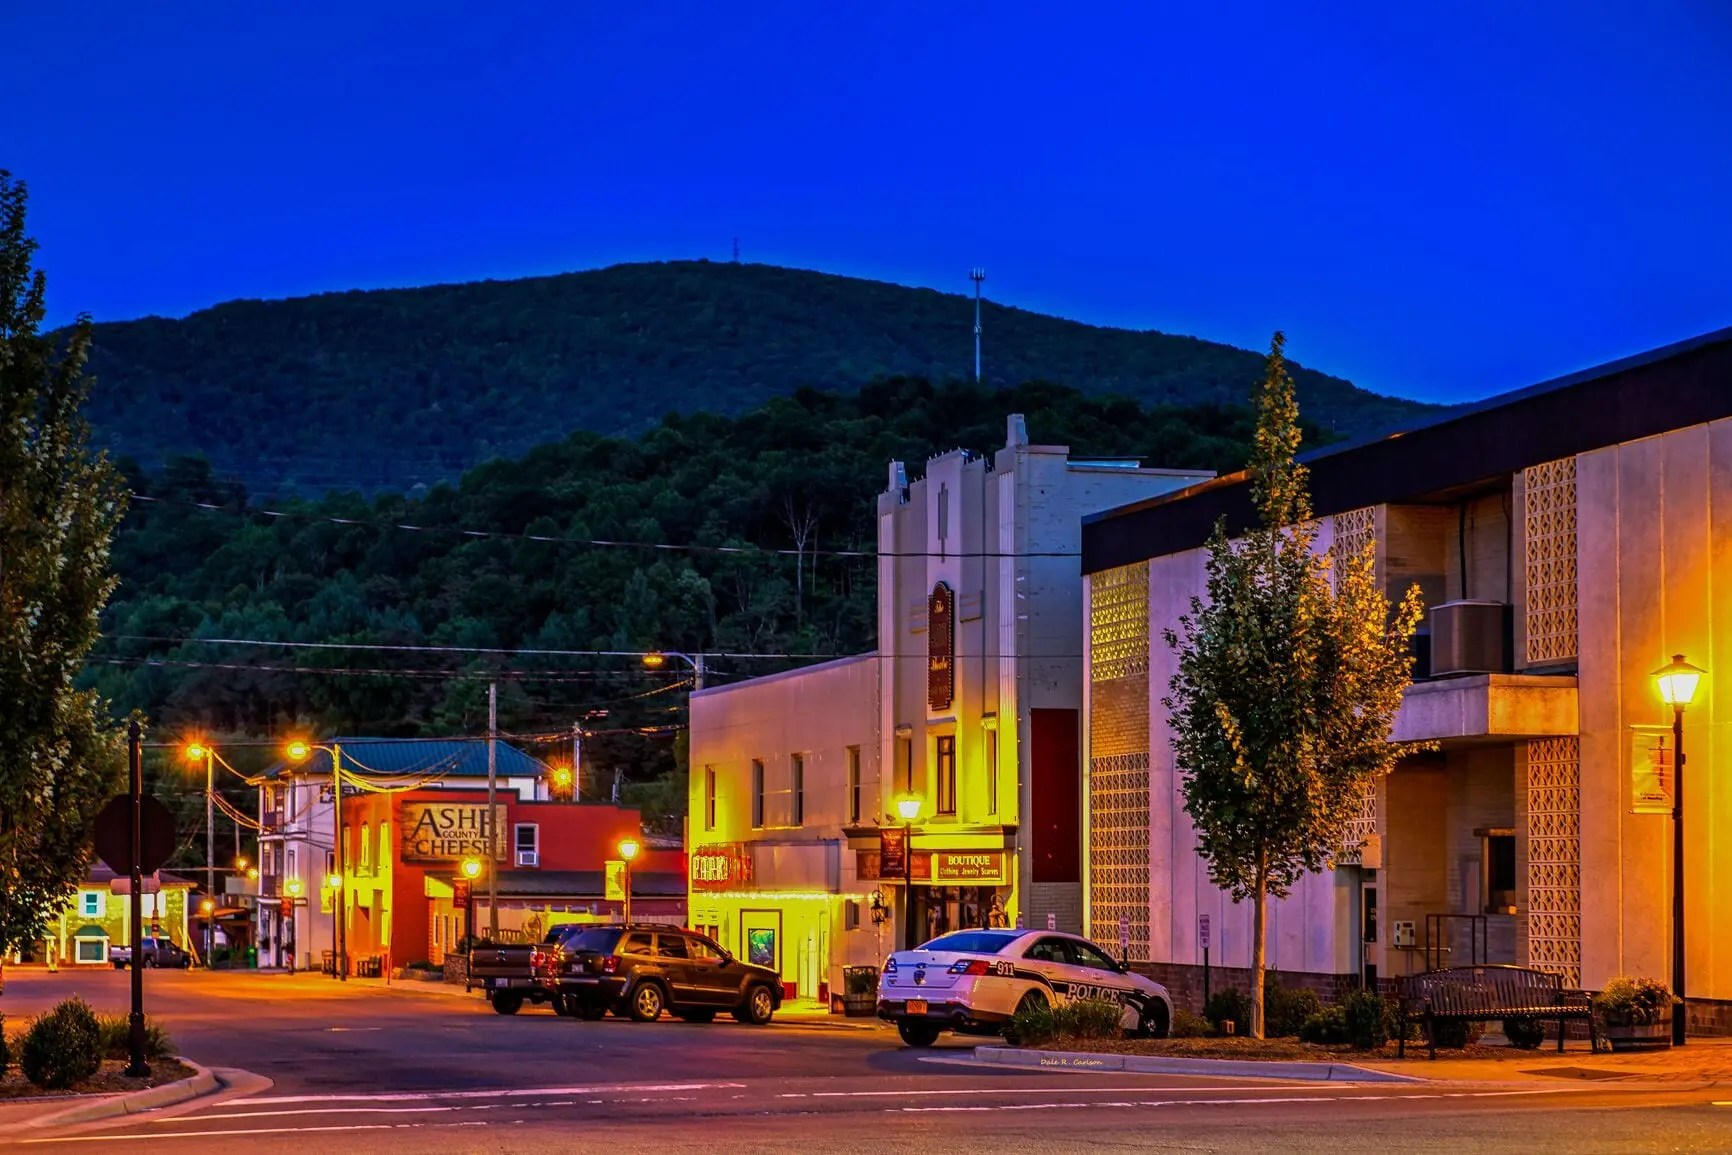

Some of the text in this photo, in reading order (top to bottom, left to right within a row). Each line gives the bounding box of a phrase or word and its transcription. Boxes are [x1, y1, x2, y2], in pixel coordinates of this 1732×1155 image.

[405, 808, 498, 840] ASHE
[442, 830, 479, 839] COUNTY
[948, 855, 991, 868] BOUTIQUE
[940, 867, 999, 877] Clothing Jewelry Scarves
[997, 961, 1014, 976] 911
[1066, 983, 1121, 1004] POLICE
